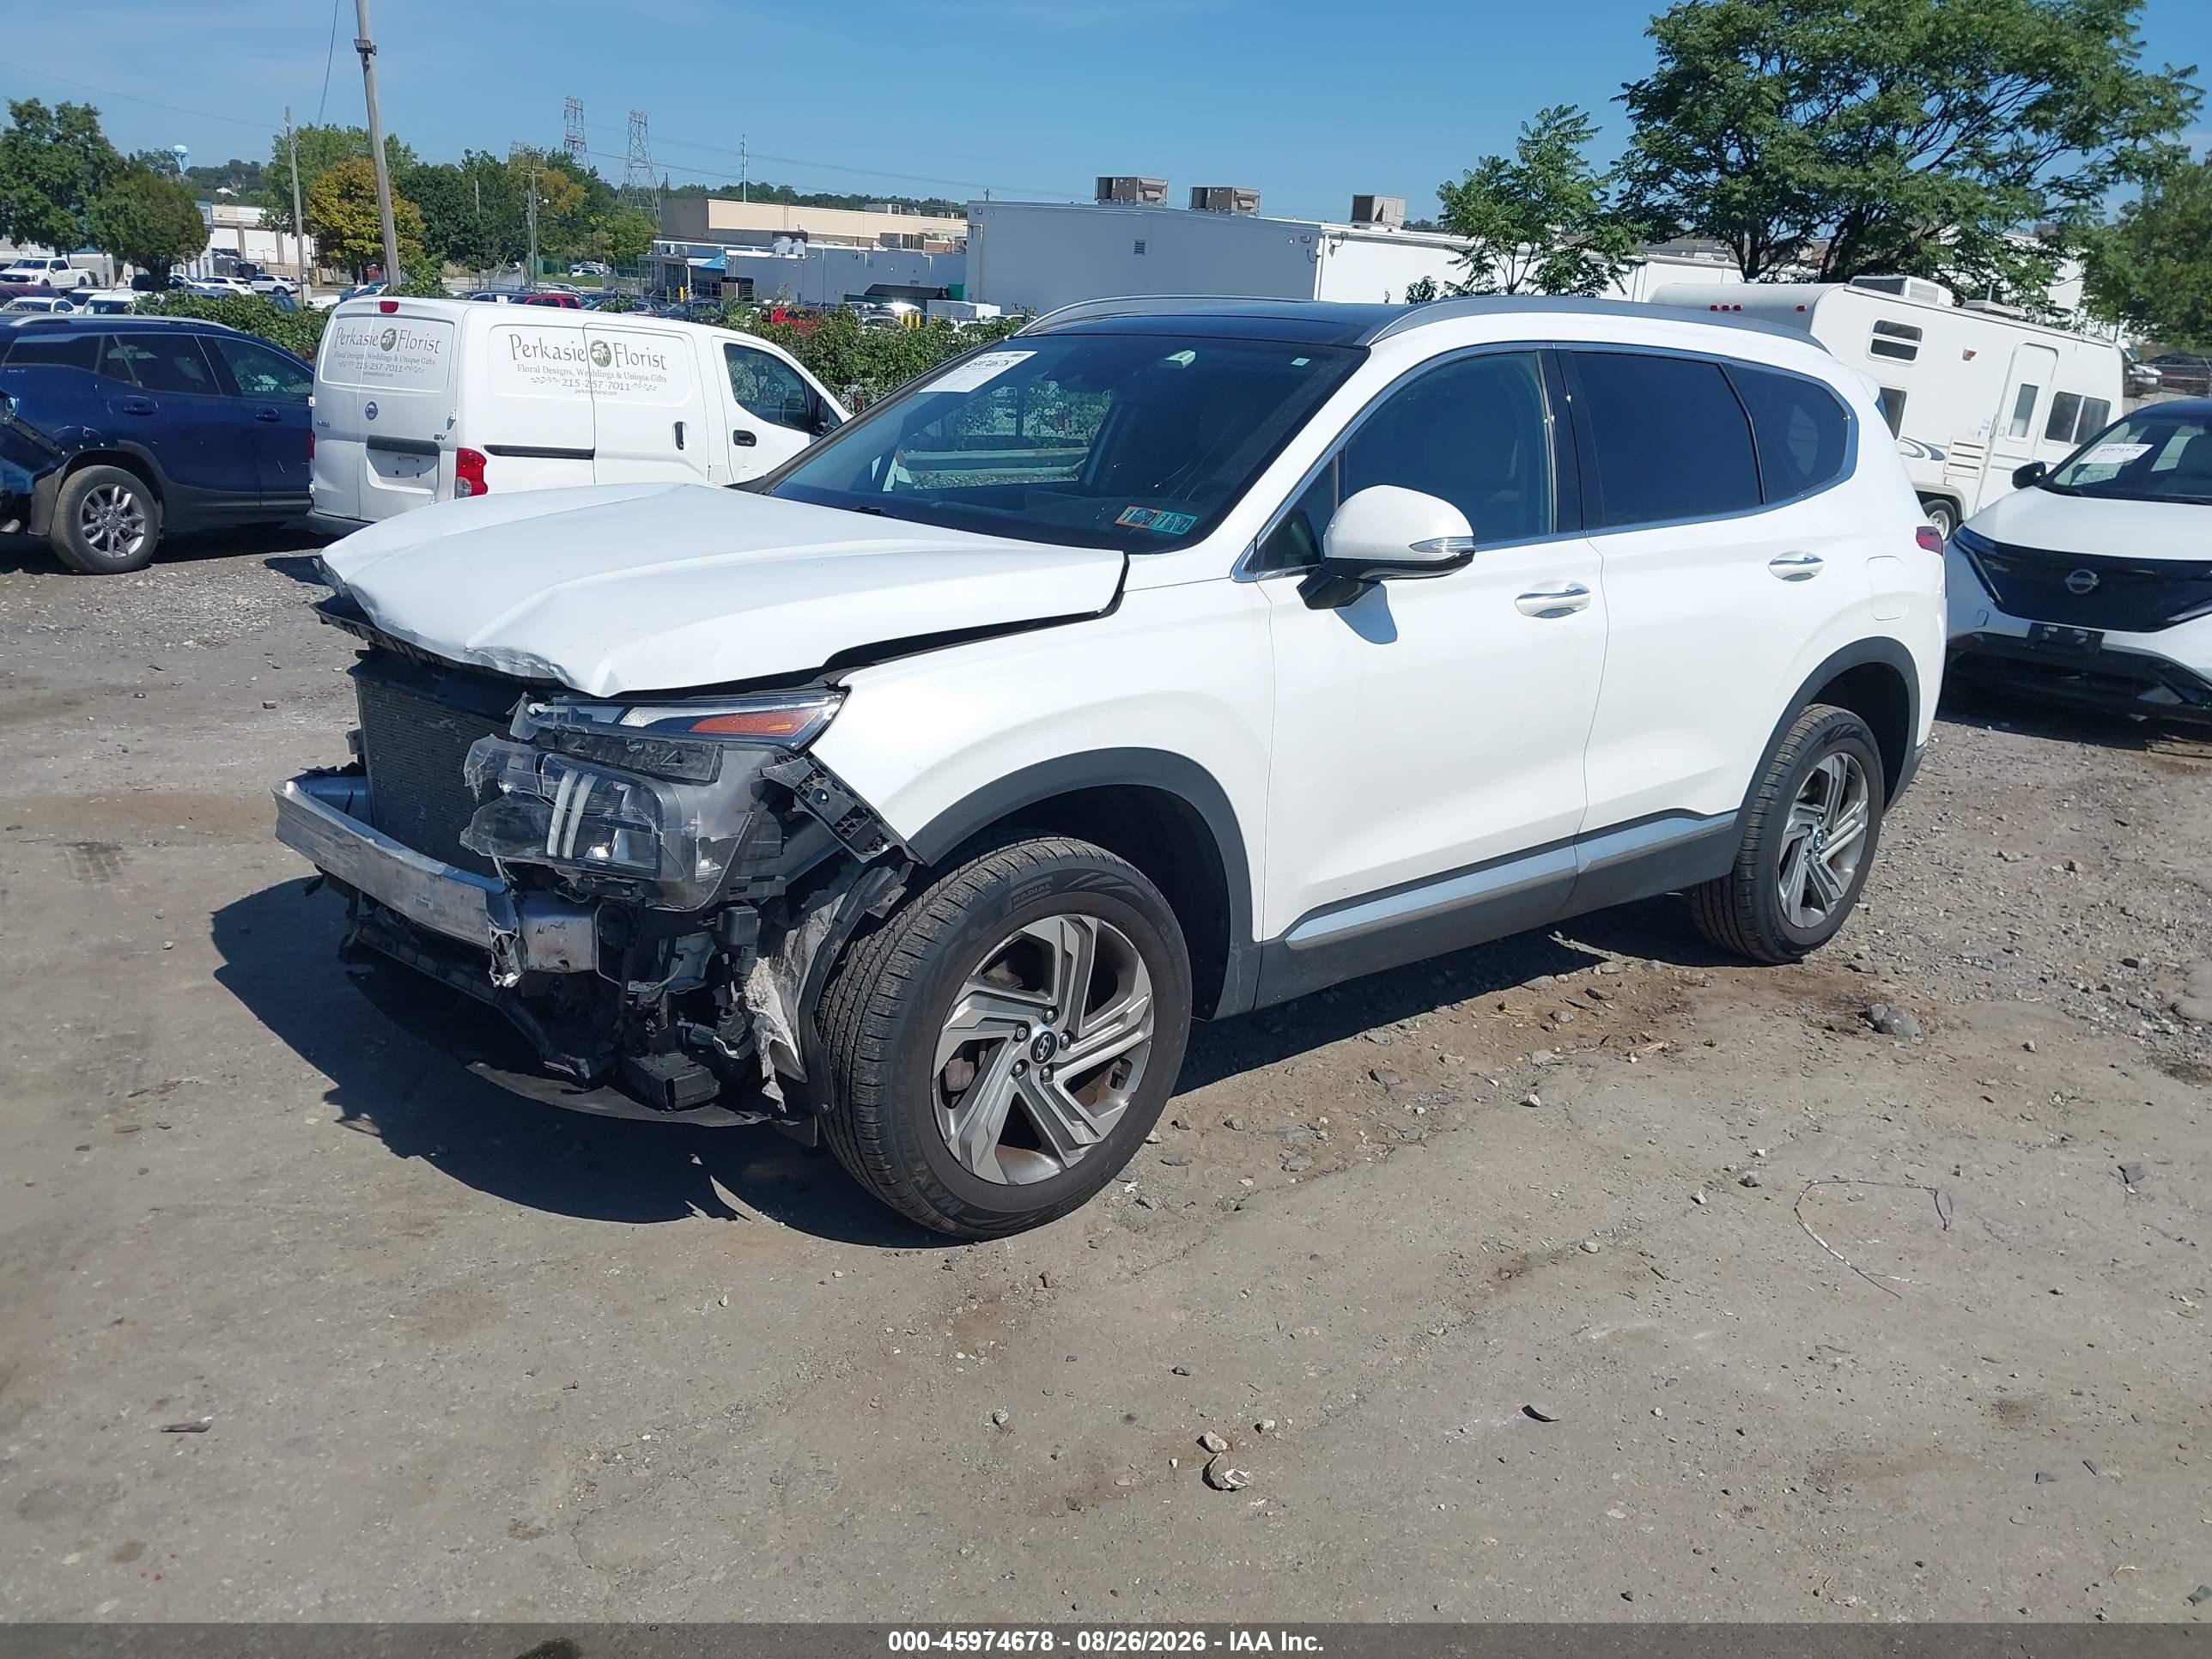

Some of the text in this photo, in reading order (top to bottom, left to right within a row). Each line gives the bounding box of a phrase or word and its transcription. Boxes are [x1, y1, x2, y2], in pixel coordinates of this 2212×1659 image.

[334, 326, 443, 354] Perkasie Florist
[508, 334, 667, 370] Perkasie Florist
[517, 363, 540, 374] Floral
[542, 366, 574, 376] Designs,
[576, 368, 614, 380] Weddings
[624, 372, 649, 382] Unique
[562, 379, 629, 391] 215-257-7011
[1012, 883, 1052, 904] RADIAL
